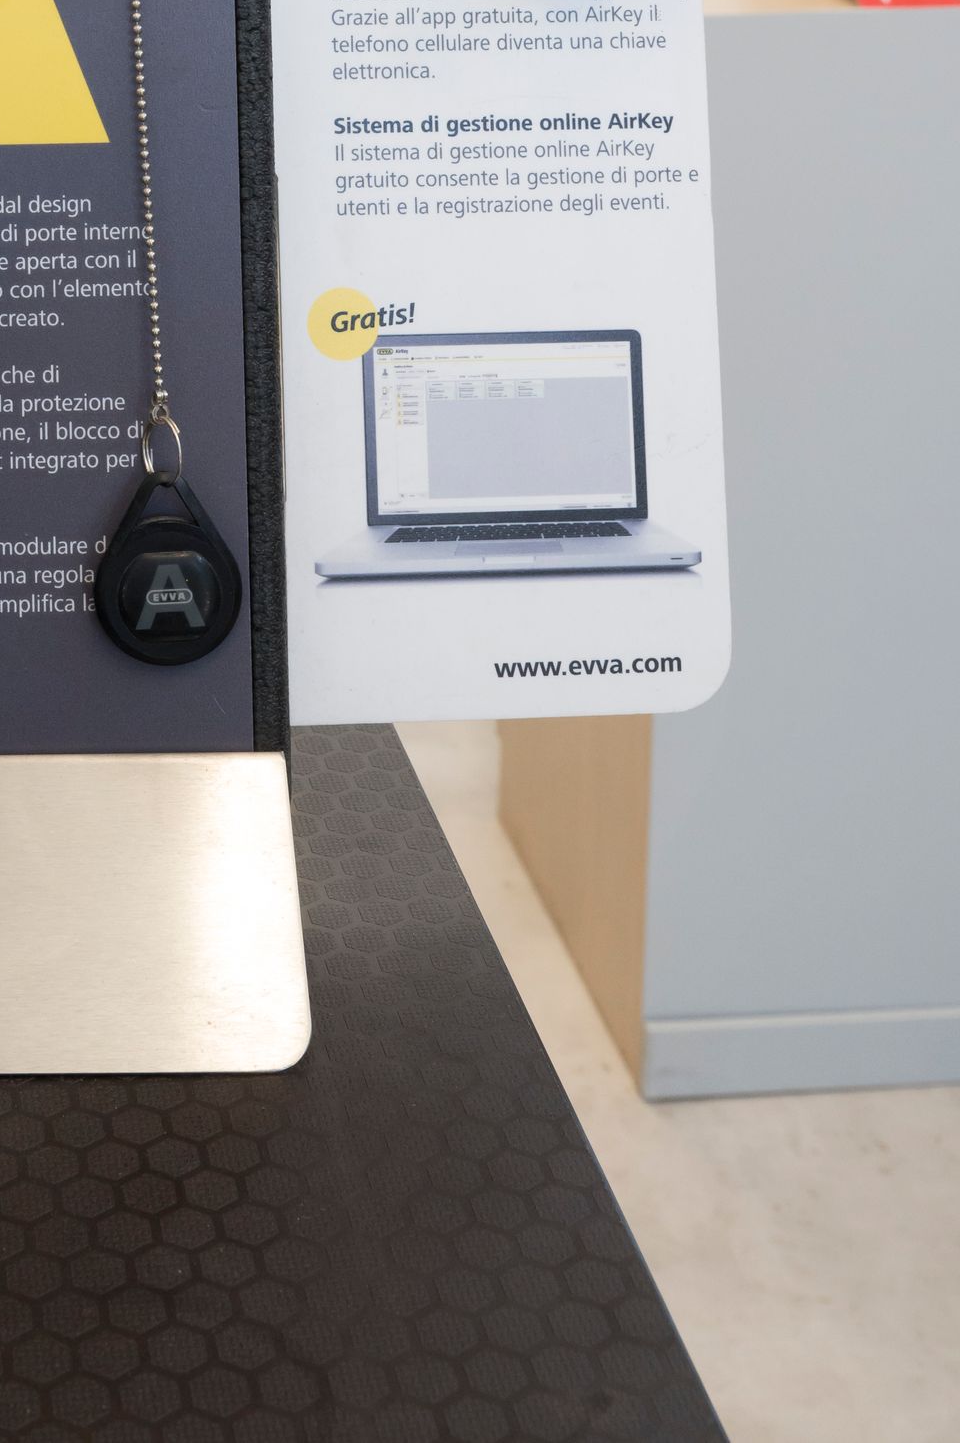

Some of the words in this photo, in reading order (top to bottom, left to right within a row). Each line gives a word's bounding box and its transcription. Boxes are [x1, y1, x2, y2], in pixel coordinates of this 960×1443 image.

[331, 8, 389, 26] Grazie
[463, 7, 538, 29] gratuita,
[546, 10, 578, 23] con
[585, 5, 643, 27] AirKey
[650, 4, 658, 22] il
[331, 34, 409, 53] telefono
[415, 34, 490, 52] cellulare
[497, 33, 563, 51] diventa
[570, 36, 603, 50] una
[610, 31, 666, 49] chiave
[333, 62, 435, 80] elettronica.
[334, 117, 414, 135] Sistema
[421, 115, 439, 133] di
[447, 114, 533, 137] gestione
[540, 113, 601, 131] online
[608, 112, 674, 133] AirKey
[336, 143, 344, 162] Il
[351, 144, 420, 161] sistema
[427, 142, 443, 160] di
[450, 142, 528, 164] gestione
[534, 140, 590, 158] online
[596, 140, 655, 161] AirKey
[336, 171, 409, 194] gratuito
[416, 171, 499, 187] consente
[506, 168, 520, 186] la
[527, 167, 605, 190] gestione
[611, 166, 627, 184] di
[634, 167, 682, 188] porte
[689, 169, 699, 182] e
[28, 195, 91, 218] design
[337, 198, 390, 216] utenti
[397, 202, 407, 215] e
[414, 197, 429, 215] la
[436, 195, 553, 219] registrazione
[560, 193, 603, 216] degli
[610, 192, 669, 211] eventi.
[1, 223, 18, 242] di
[25, 225, 77, 247] porte
[330, 302, 415, 333] Gratis!
[42, 364, 59, 383] di
[21, 393, 125, 417] protezione
[152, 592, 186, 602] EVVA
[494, 657, 682, 678] www.evva.com
